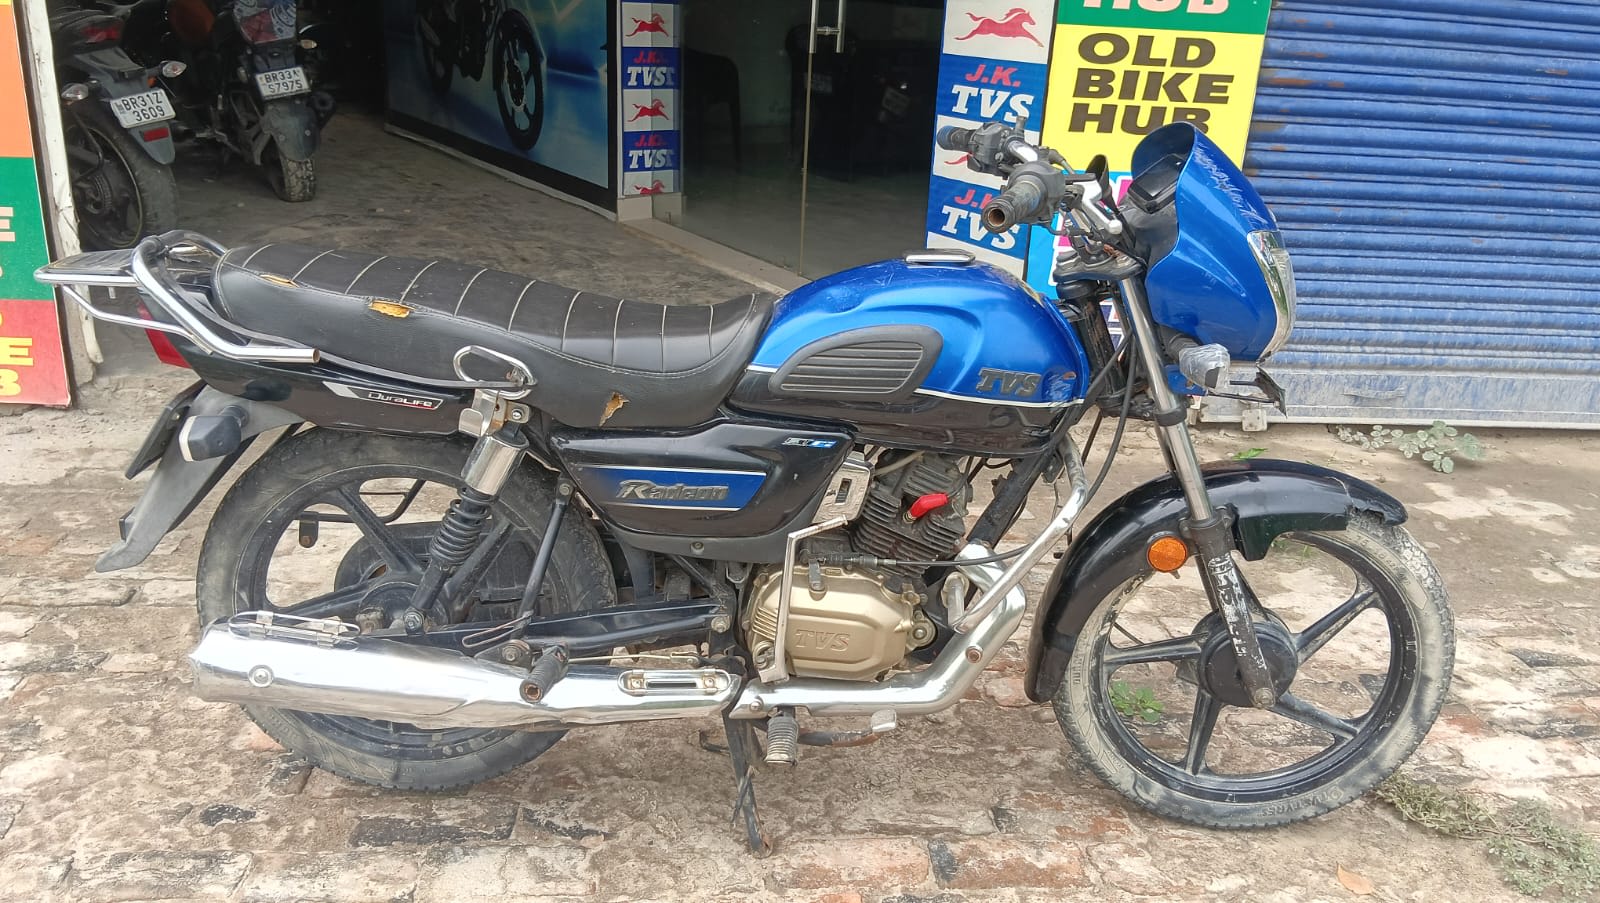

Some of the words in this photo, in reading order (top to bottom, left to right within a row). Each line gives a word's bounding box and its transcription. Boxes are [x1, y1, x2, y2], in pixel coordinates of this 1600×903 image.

[1078, 33, 1216, 68] OLD
[965, 64, 1021, 87] J.K.
[1072, 68, 1234, 105] BIKE
[121, 92, 163, 111] BR31Z
[132, 105, 165, 122] 3609
[951, 84, 1034, 123] TVS
[941, 205, 1020, 250] TVS
[976, 367, 1042, 397] TVS
[616, 479, 729, 500] Radeon
[796, 629, 851, 652] TVS
